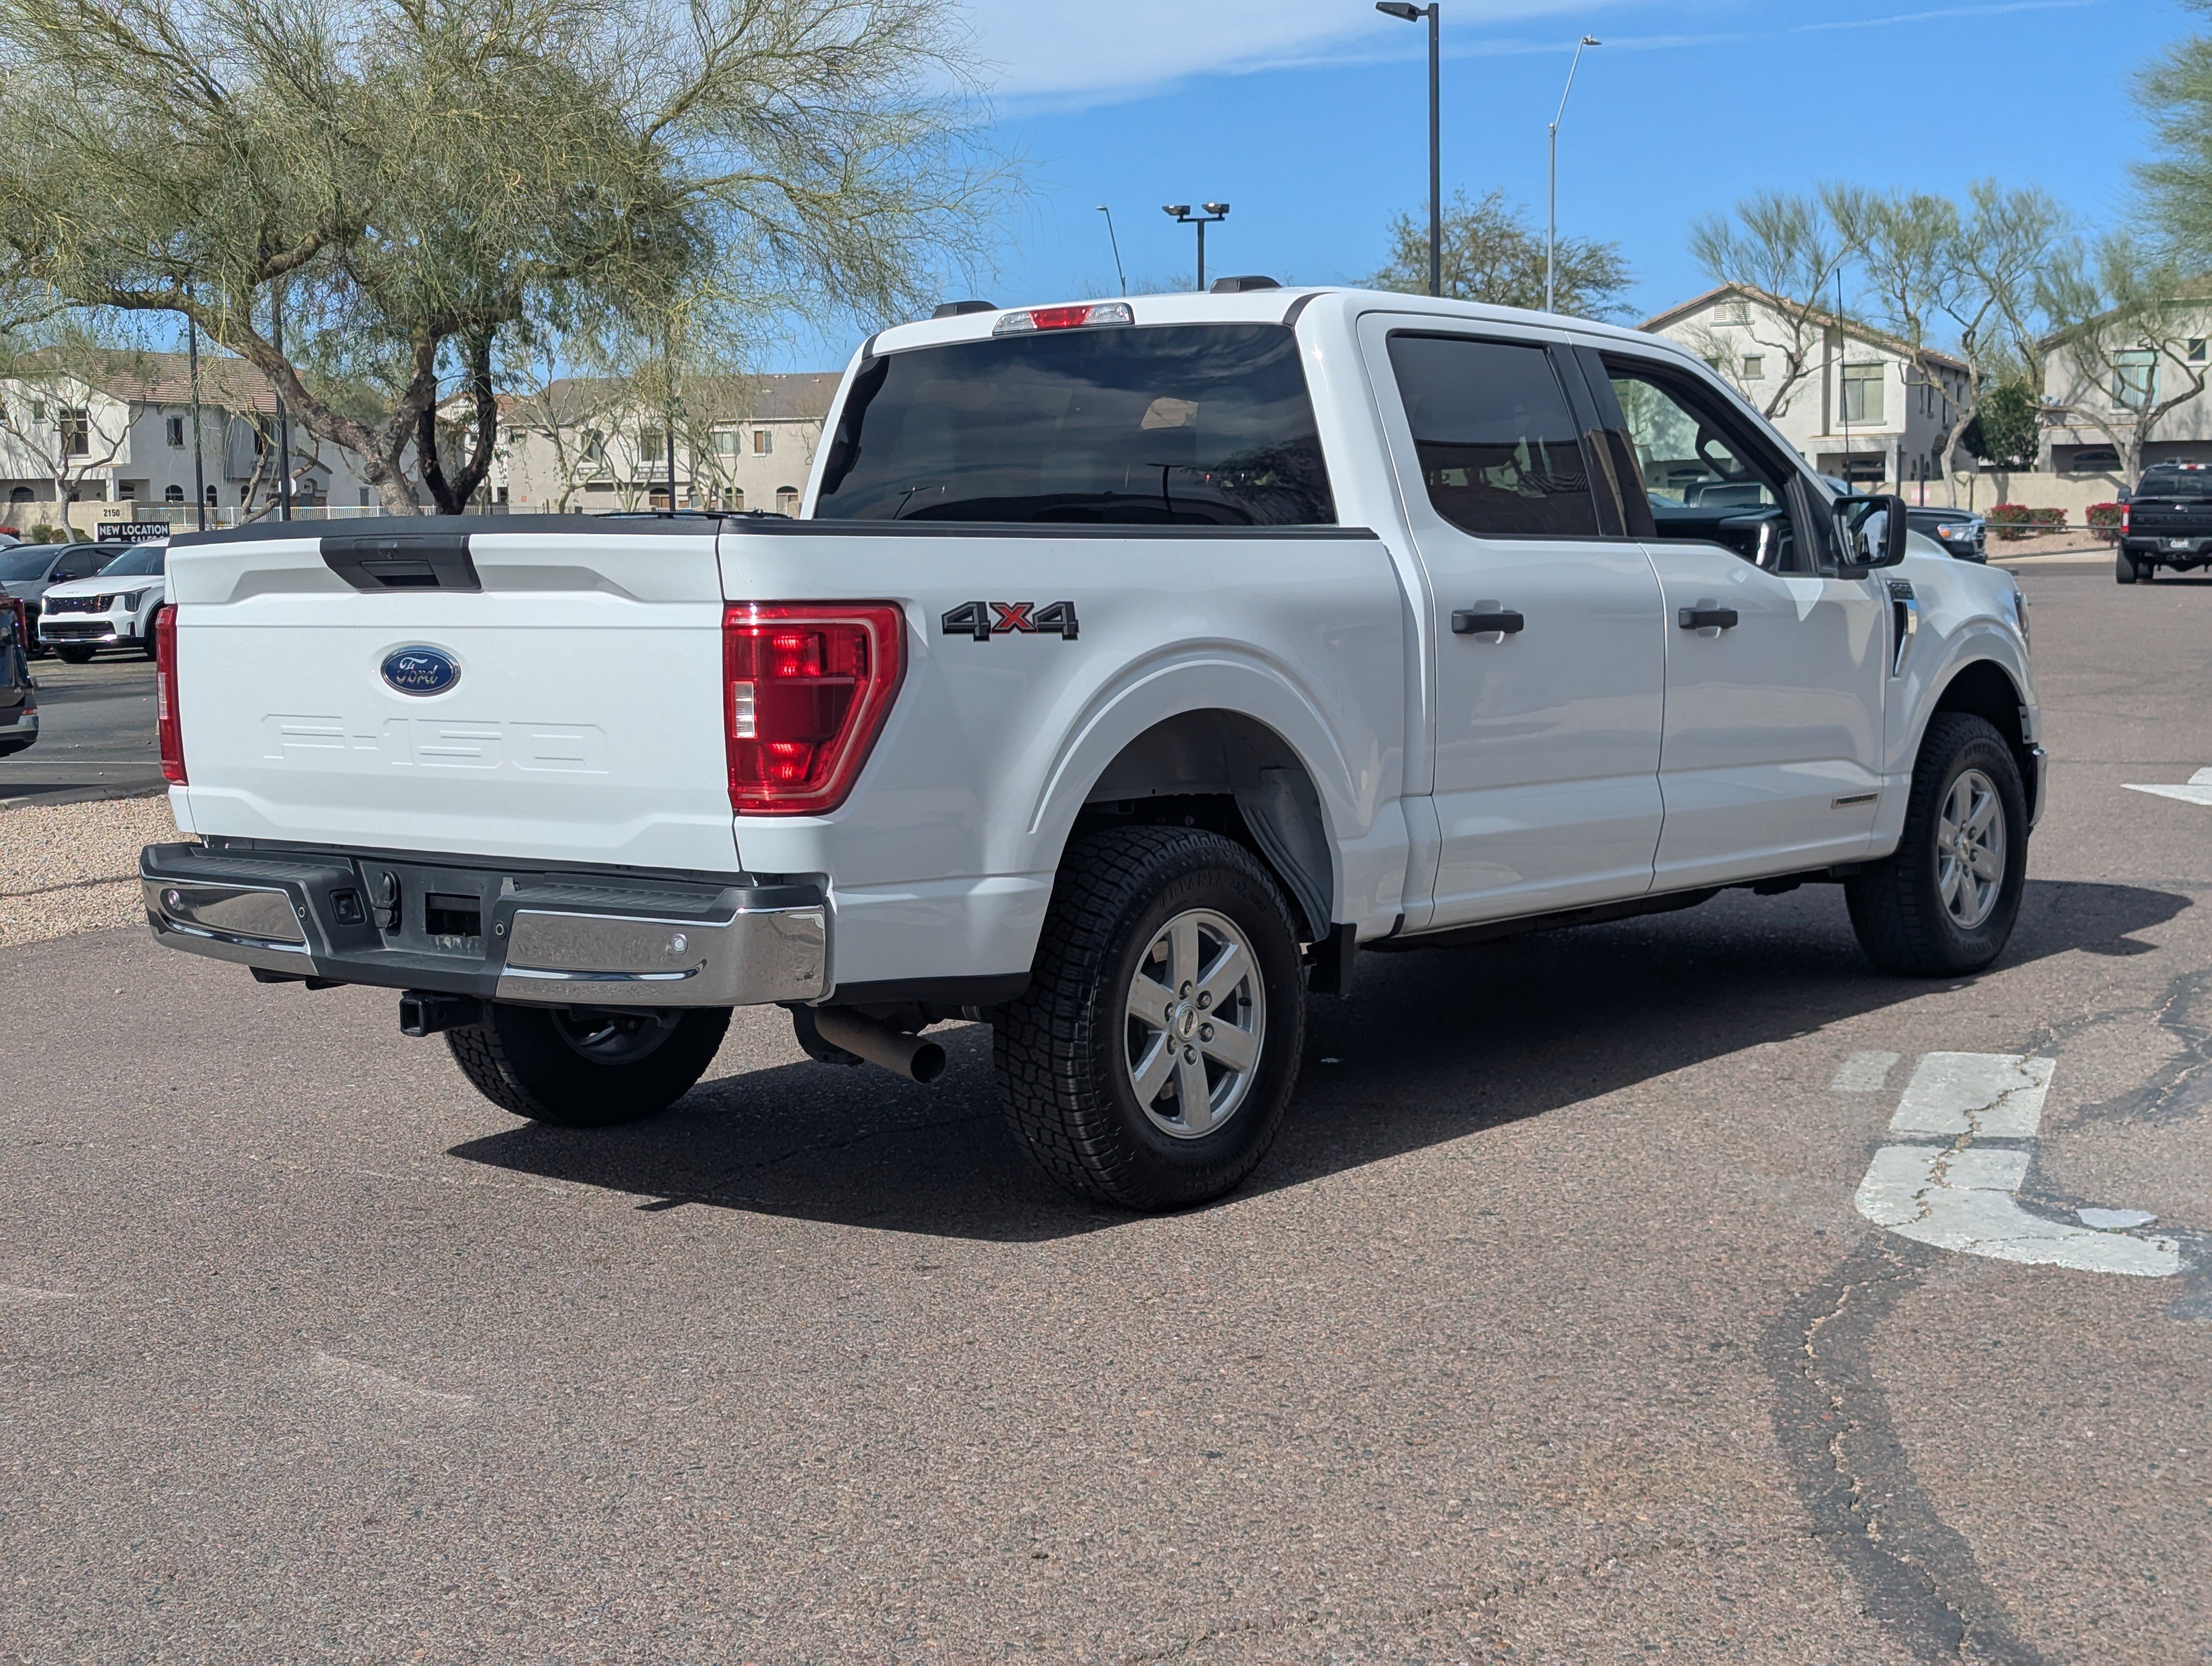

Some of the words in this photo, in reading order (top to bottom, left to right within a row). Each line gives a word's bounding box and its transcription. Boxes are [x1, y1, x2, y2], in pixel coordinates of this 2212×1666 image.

[104, 509, 120, 517] 2150
[99, 526, 120, 535] NEW
[122, 524, 169, 535] LOCATION
[396, 657, 439, 684] Ford
[261, 714, 610, 774] F-150
